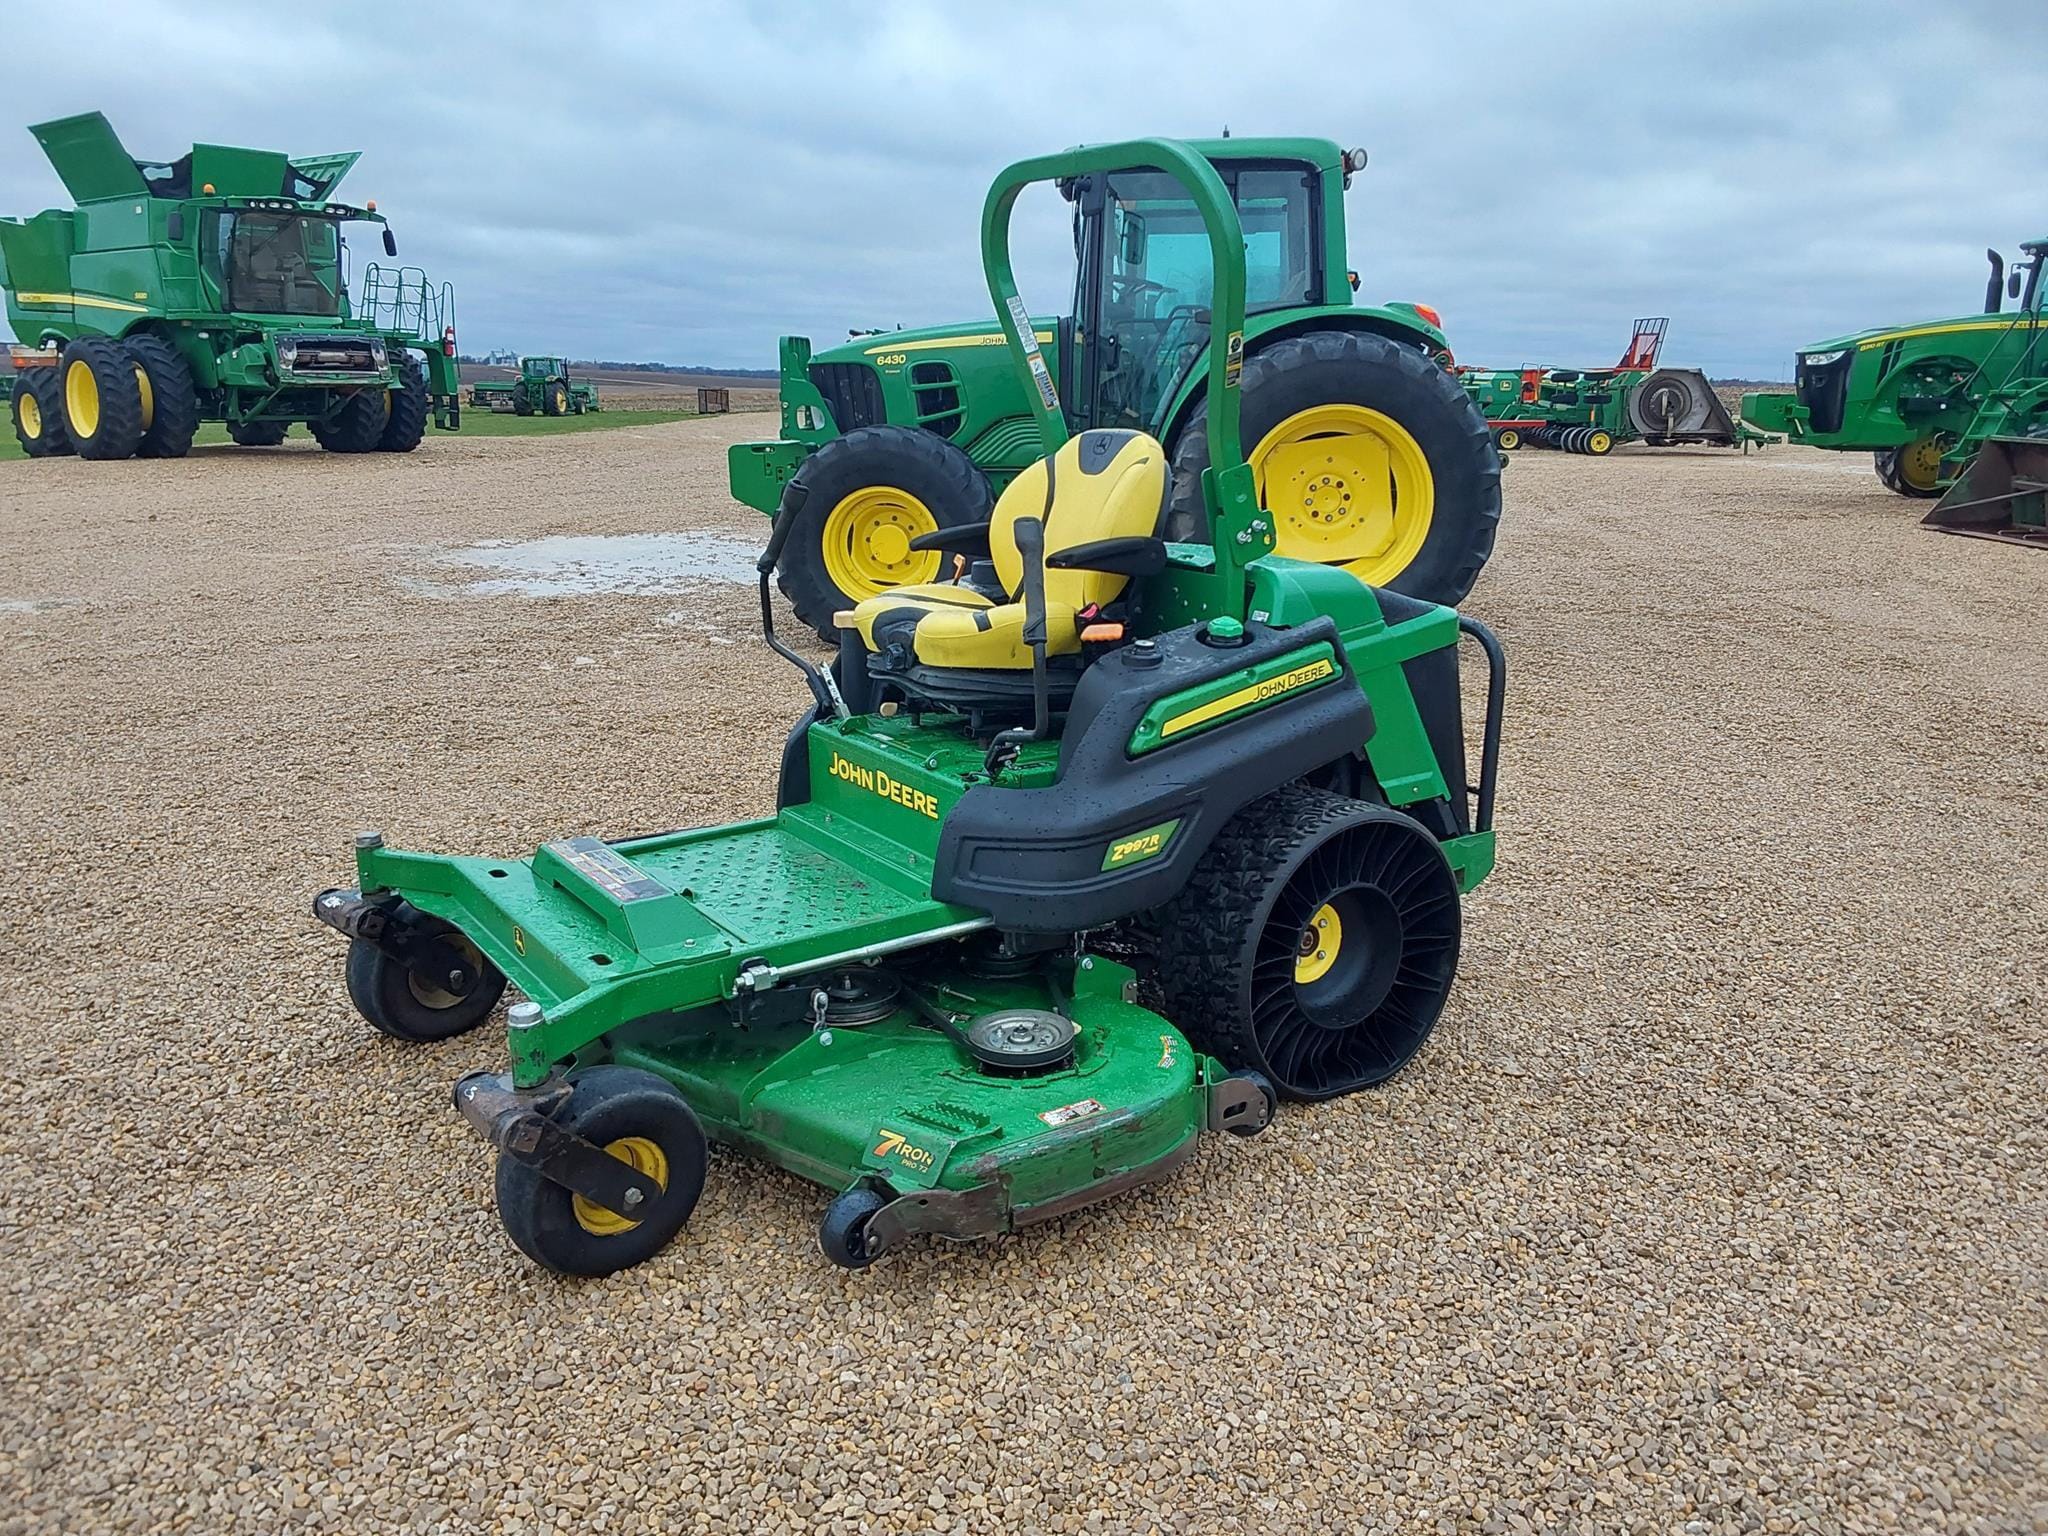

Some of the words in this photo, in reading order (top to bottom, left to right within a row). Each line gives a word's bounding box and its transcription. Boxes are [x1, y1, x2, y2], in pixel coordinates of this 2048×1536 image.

[980, 336, 1004, 345] JOHN
[876, 354, 906, 366] 6430
[1253, 679, 1287, 701] JOHN
[1287, 665, 1326, 688] DEERE
[829, 751, 874, 791] JOHN
[876, 769, 939, 819] DEERE
[901, 1158, 917, 1169] PRO
[918, 1165, 928, 1174] 72
